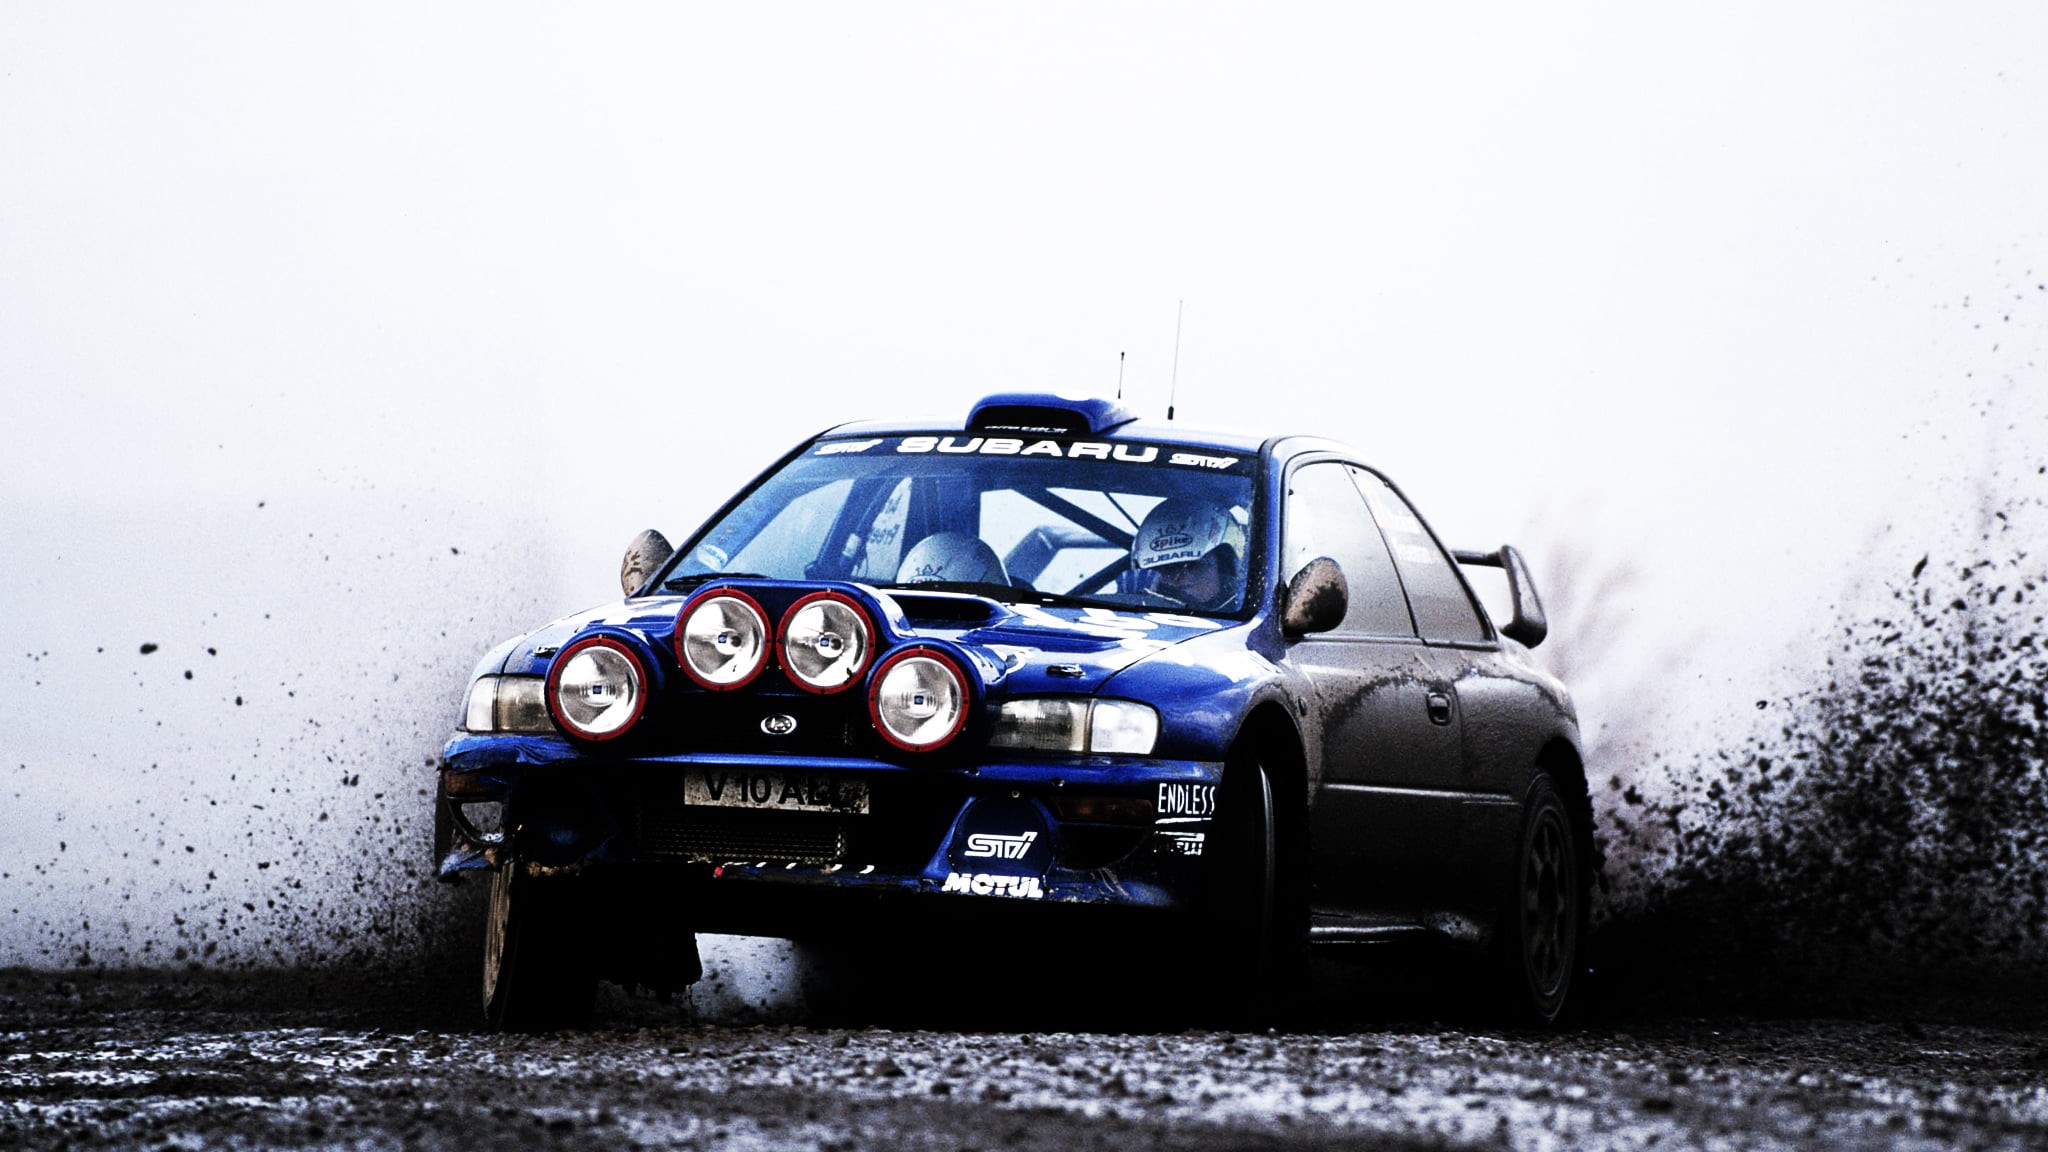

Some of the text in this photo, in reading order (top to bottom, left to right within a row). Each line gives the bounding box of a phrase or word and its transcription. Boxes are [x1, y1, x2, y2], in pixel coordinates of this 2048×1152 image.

[897, 436, 1159, 463] SUBARU
[1144, 550, 1201, 566] SUBARU
[1157, 782, 1216, 815] ENDLESS
[941, 872, 1044, 899] MOTUL
